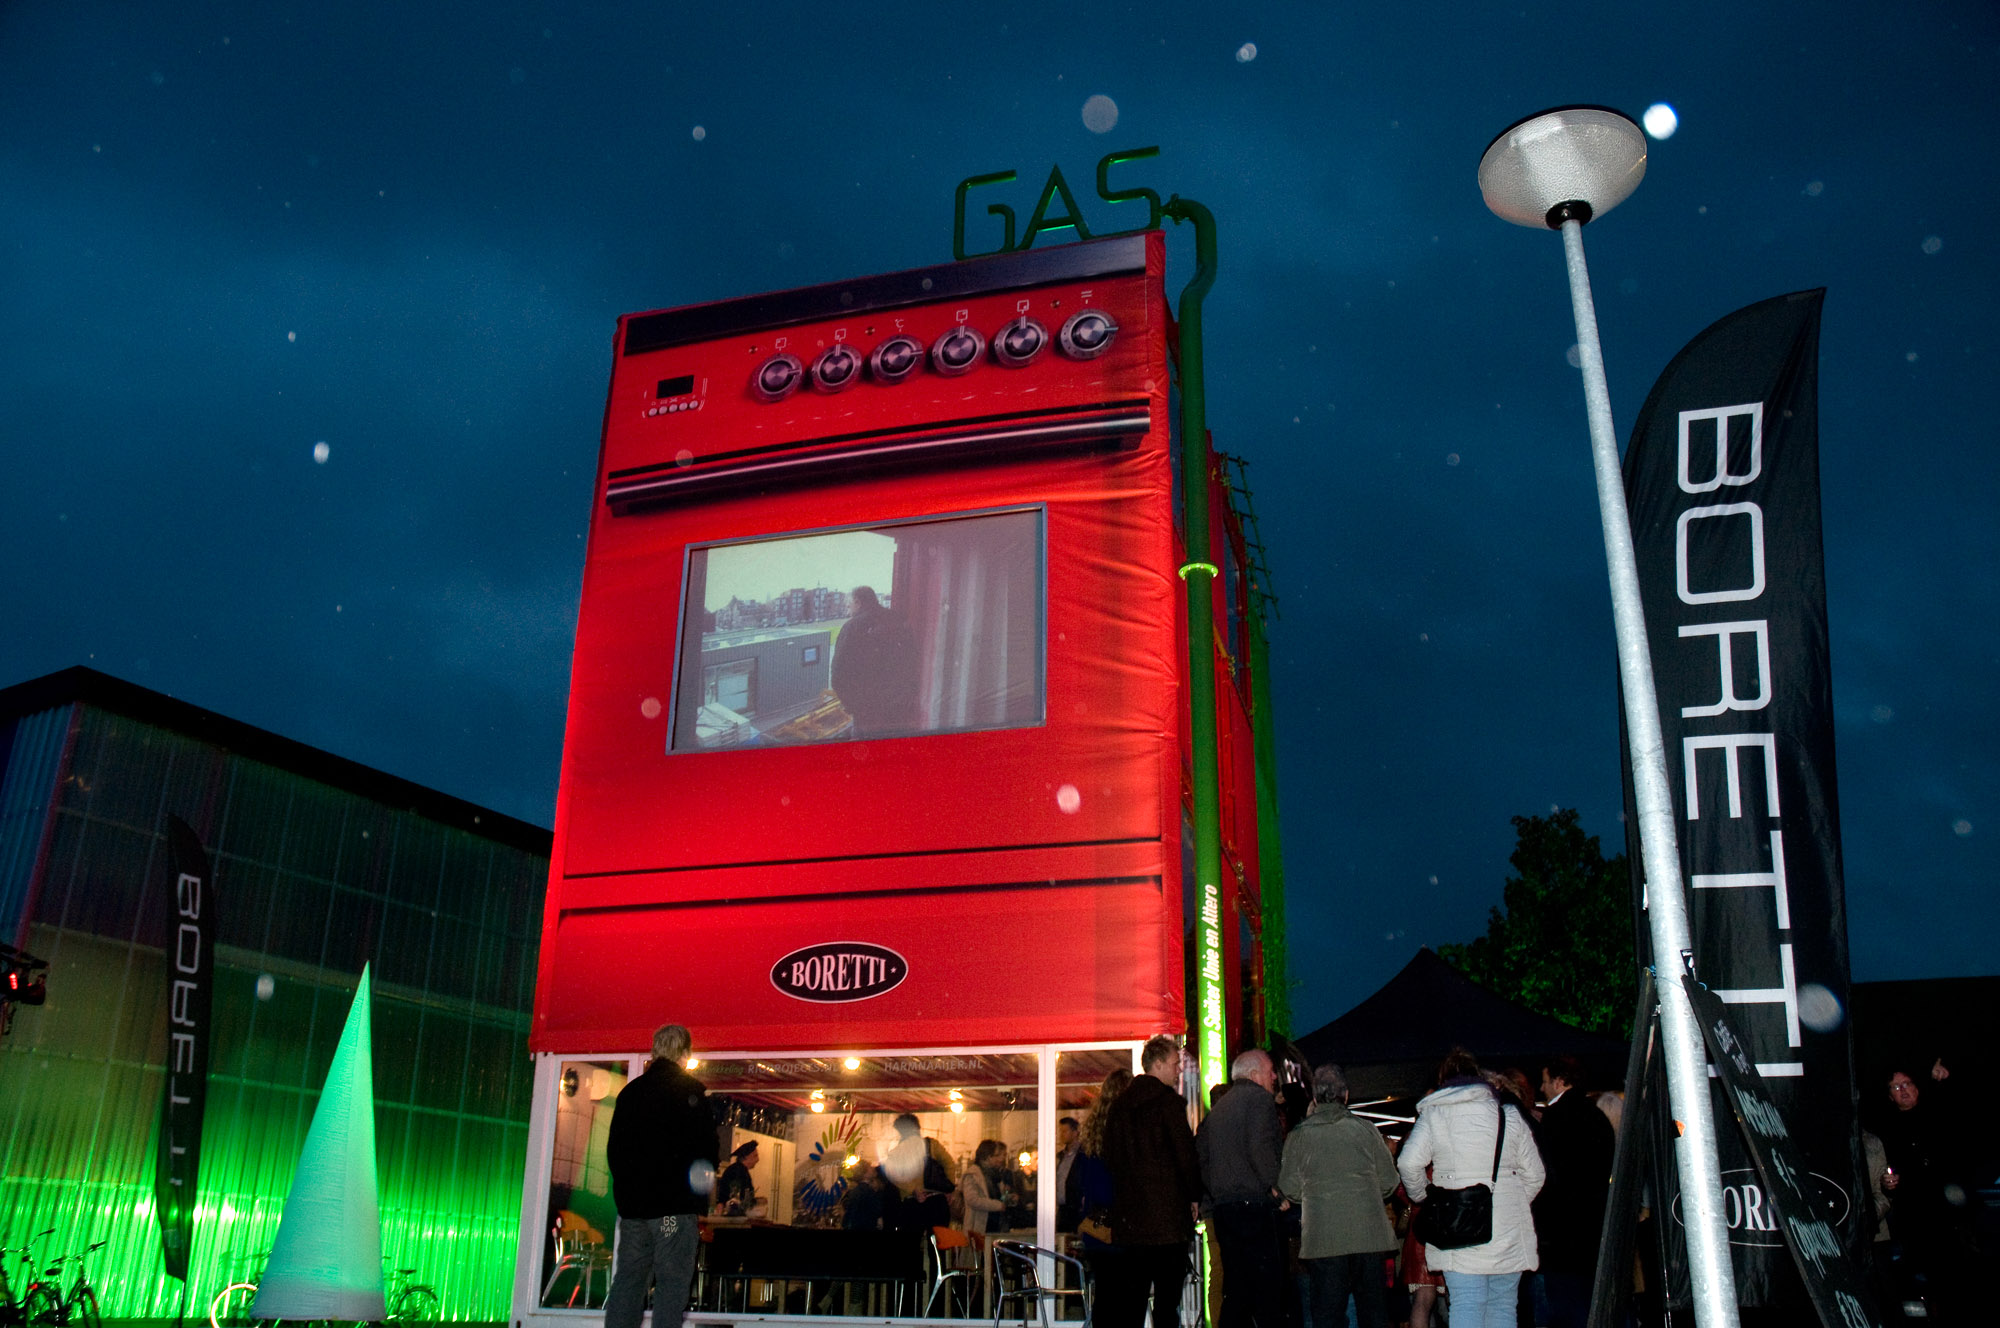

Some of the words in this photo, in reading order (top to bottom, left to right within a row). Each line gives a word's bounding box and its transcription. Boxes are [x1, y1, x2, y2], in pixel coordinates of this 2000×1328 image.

[953, 146, 1161, 261] GAS
[1676, 401, 1804, 1077] BORETTI
[1201, 884, 1218, 928] Attero
[1204, 929, 1218, 948] en
[791, 953, 886, 991] BORETTI
[1202, 949, 1220, 982] Unie
[1203, 982, 1221, 1030] Suiker
